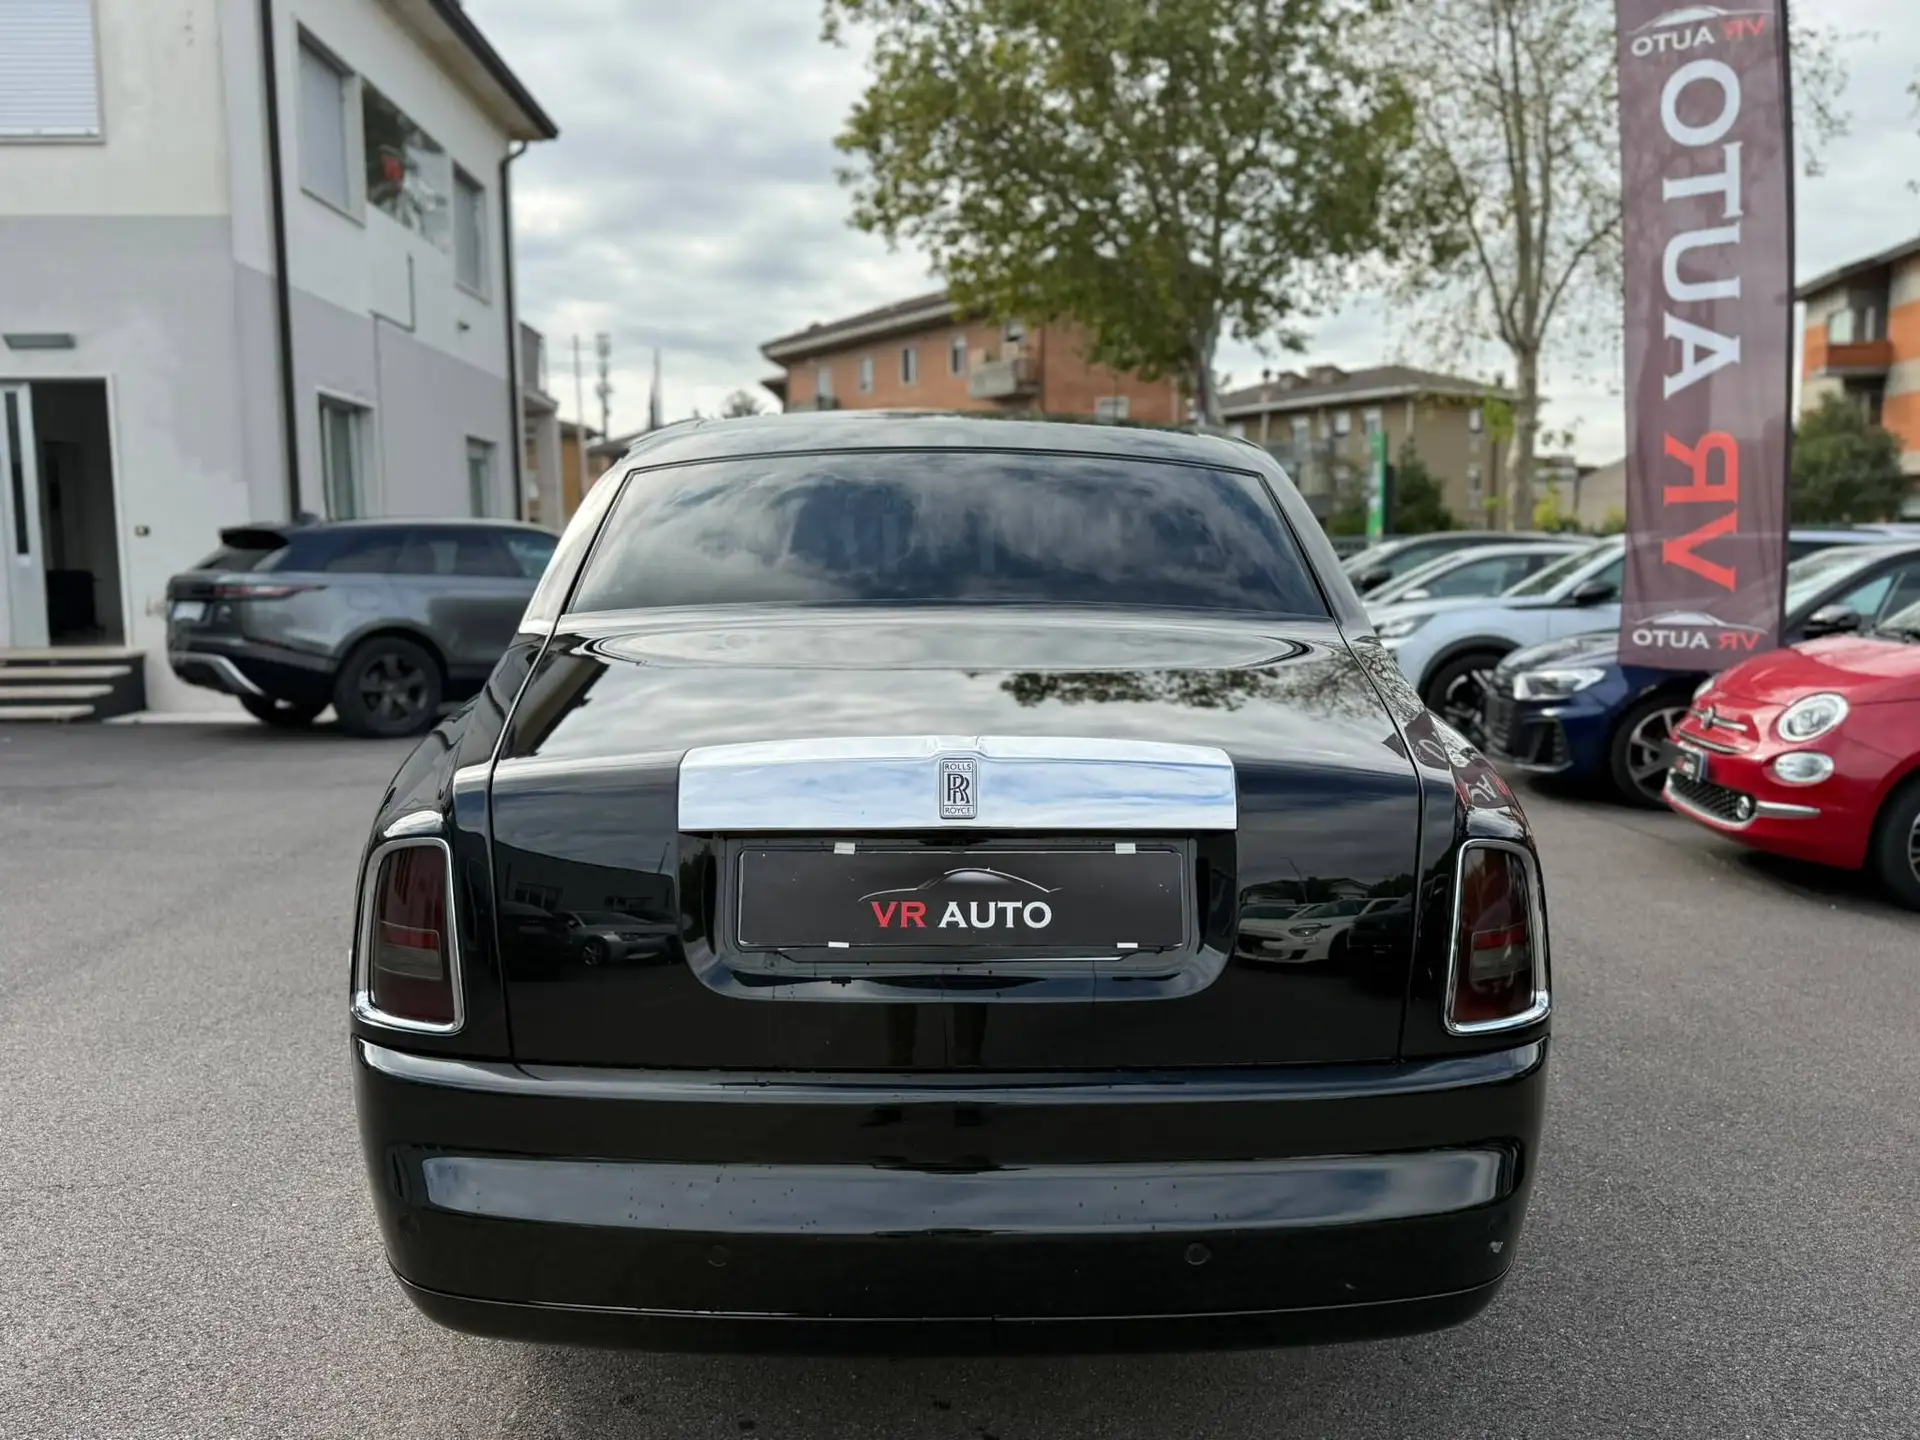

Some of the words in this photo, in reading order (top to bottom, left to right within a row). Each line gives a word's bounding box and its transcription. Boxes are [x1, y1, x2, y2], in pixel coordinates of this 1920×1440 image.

[944, 763, 972, 771] ROLLS
[871, 901, 928, 928] VR
[937, 901, 1052, 929] AUTO
